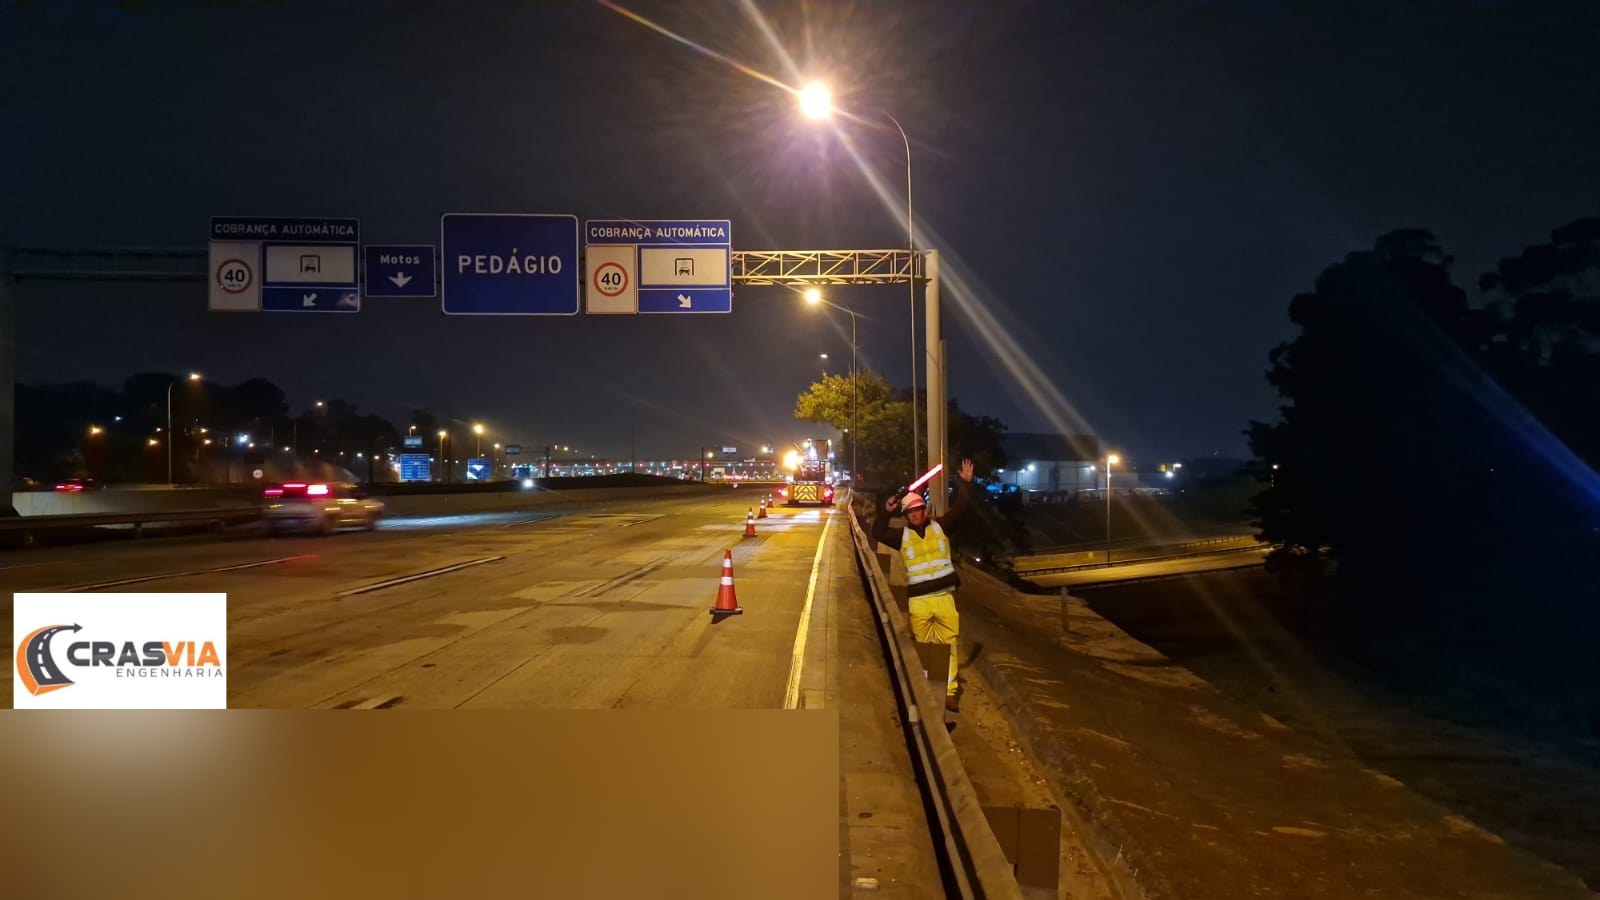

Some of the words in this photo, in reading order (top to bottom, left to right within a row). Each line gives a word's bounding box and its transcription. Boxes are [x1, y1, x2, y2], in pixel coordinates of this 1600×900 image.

[215, 223, 278, 236] COBRANÇA
[282, 222, 354, 236] AUTOMÁTICA
[591, 227, 651, 239] COBRANÇA
[656, 224, 725, 238] AUTOMÁTICA
[380, 254, 420, 265] Motos
[458, 248, 562, 274] PEDÁGIO
[224, 269, 245, 282] 40
[601, 272, 621, 286] 40
